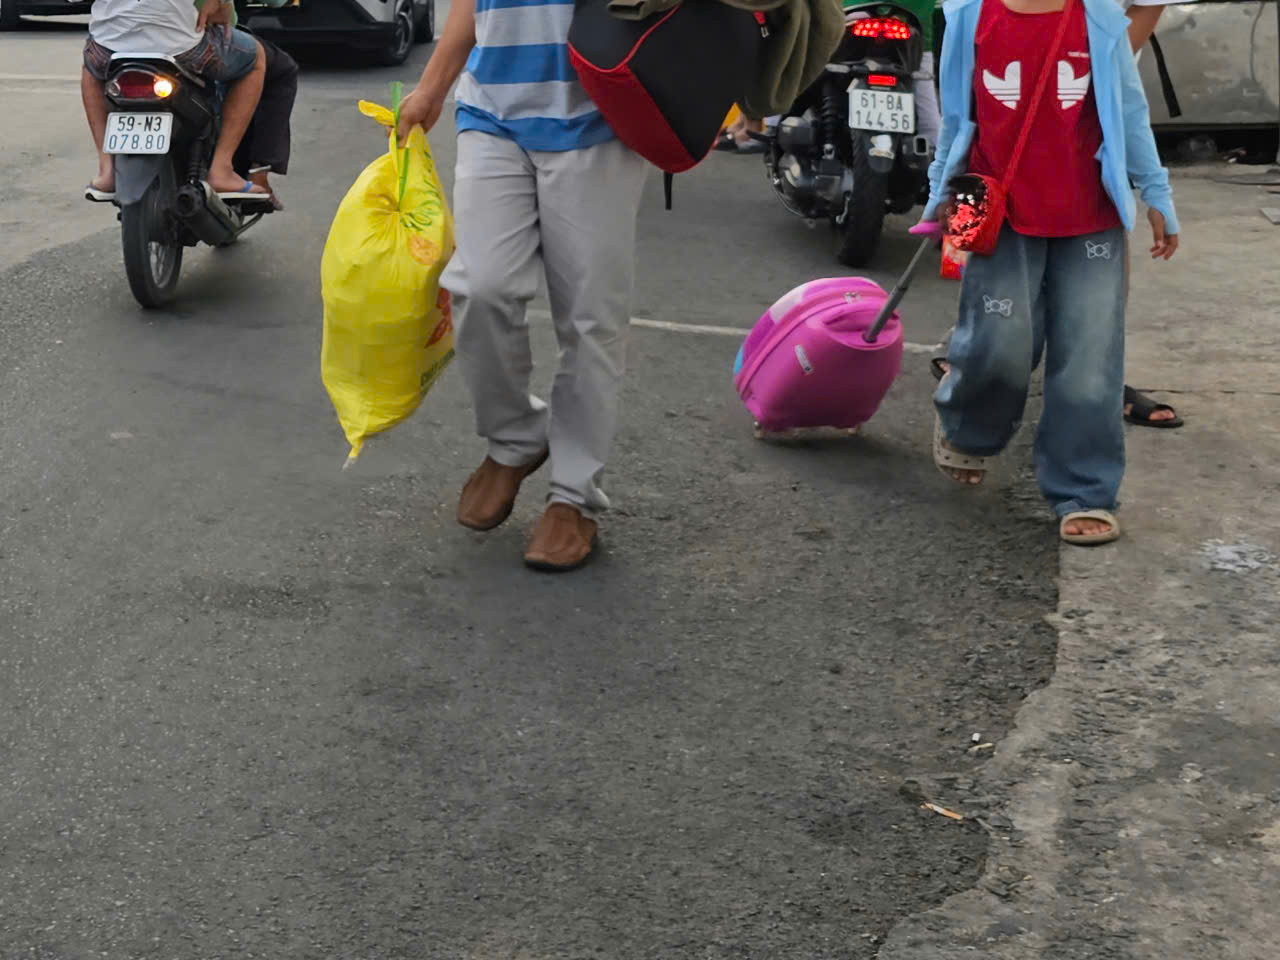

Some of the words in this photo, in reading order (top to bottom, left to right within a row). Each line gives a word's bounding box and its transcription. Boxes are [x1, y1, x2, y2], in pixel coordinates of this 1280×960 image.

[860, 92, 903, 111] 61-BA
[117, 115, 163, 132] 59-N3
[855, 110, 910, 130] 144.56
[108, 134, 166, 150] 078.80
